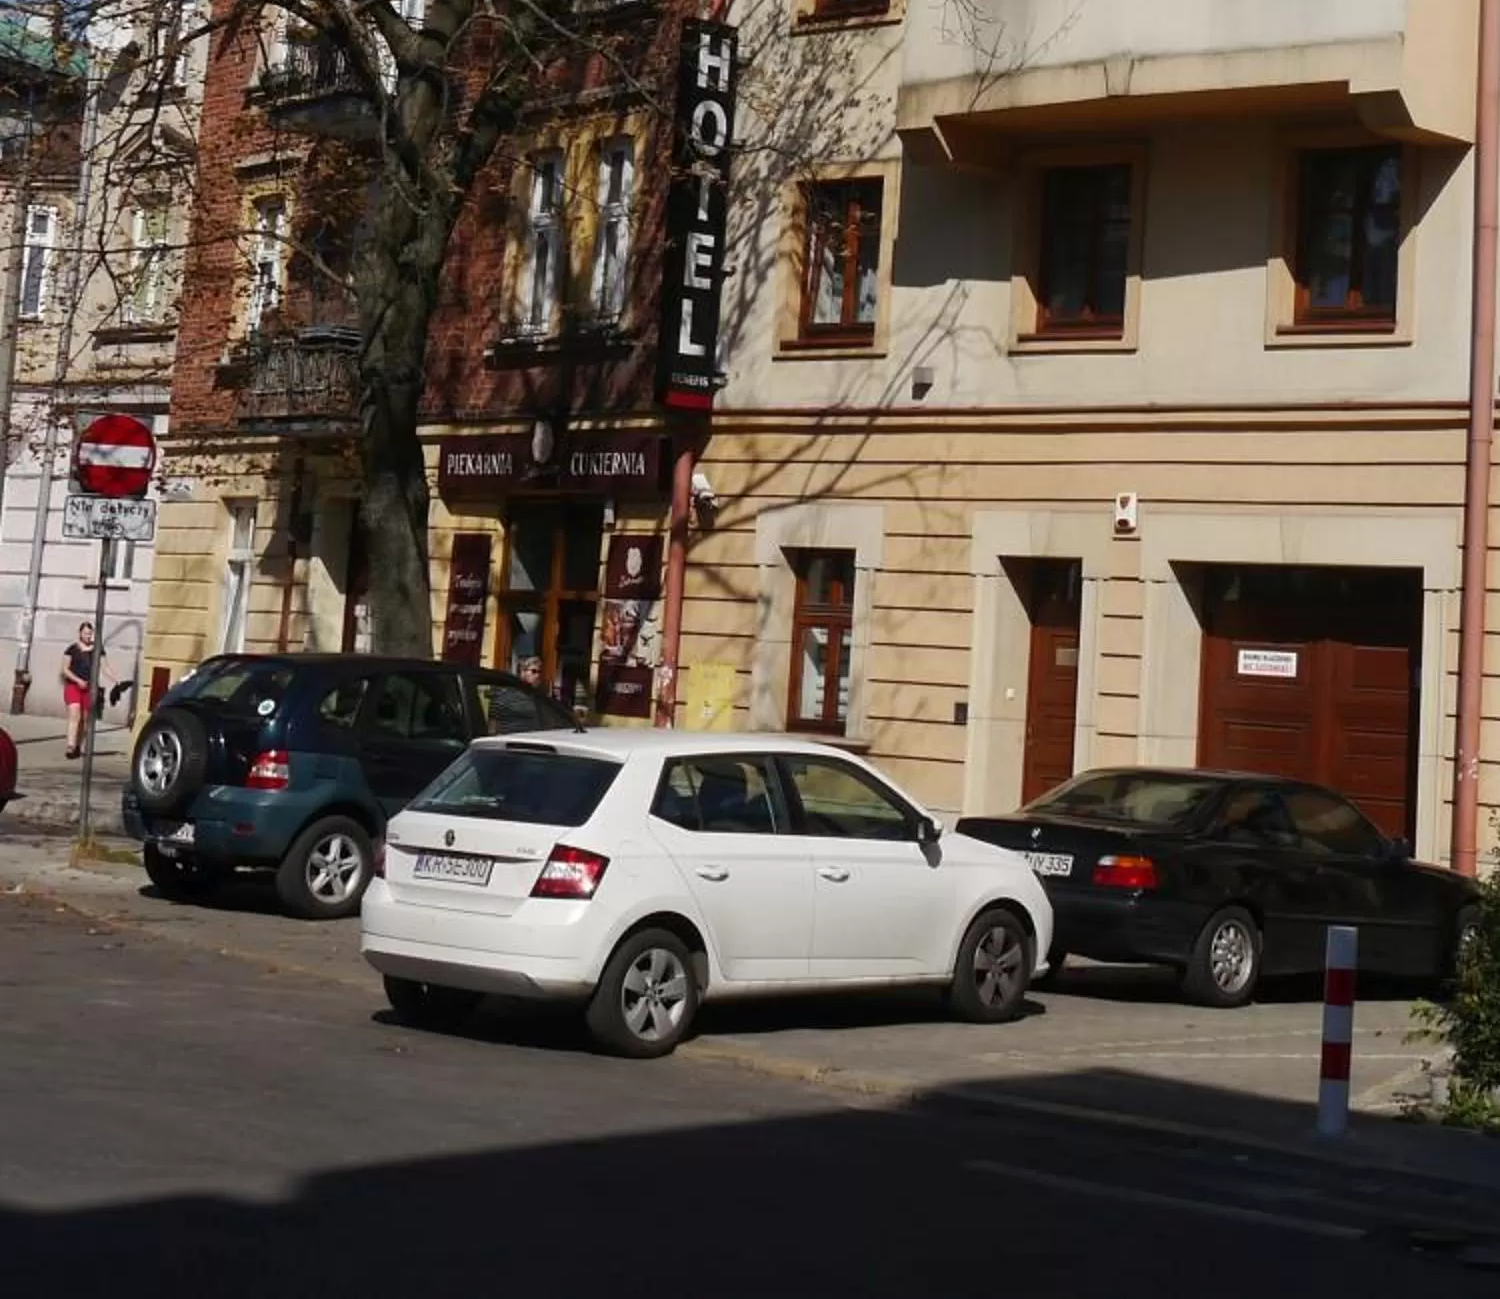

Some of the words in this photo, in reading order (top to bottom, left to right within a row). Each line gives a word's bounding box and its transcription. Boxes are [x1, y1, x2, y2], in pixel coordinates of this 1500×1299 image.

[679, 33, 732, 356] HOTEL
[447, 453, 513, 475] PIEKARNIA
[570, 452, 645, 475] CUKIERNIA
